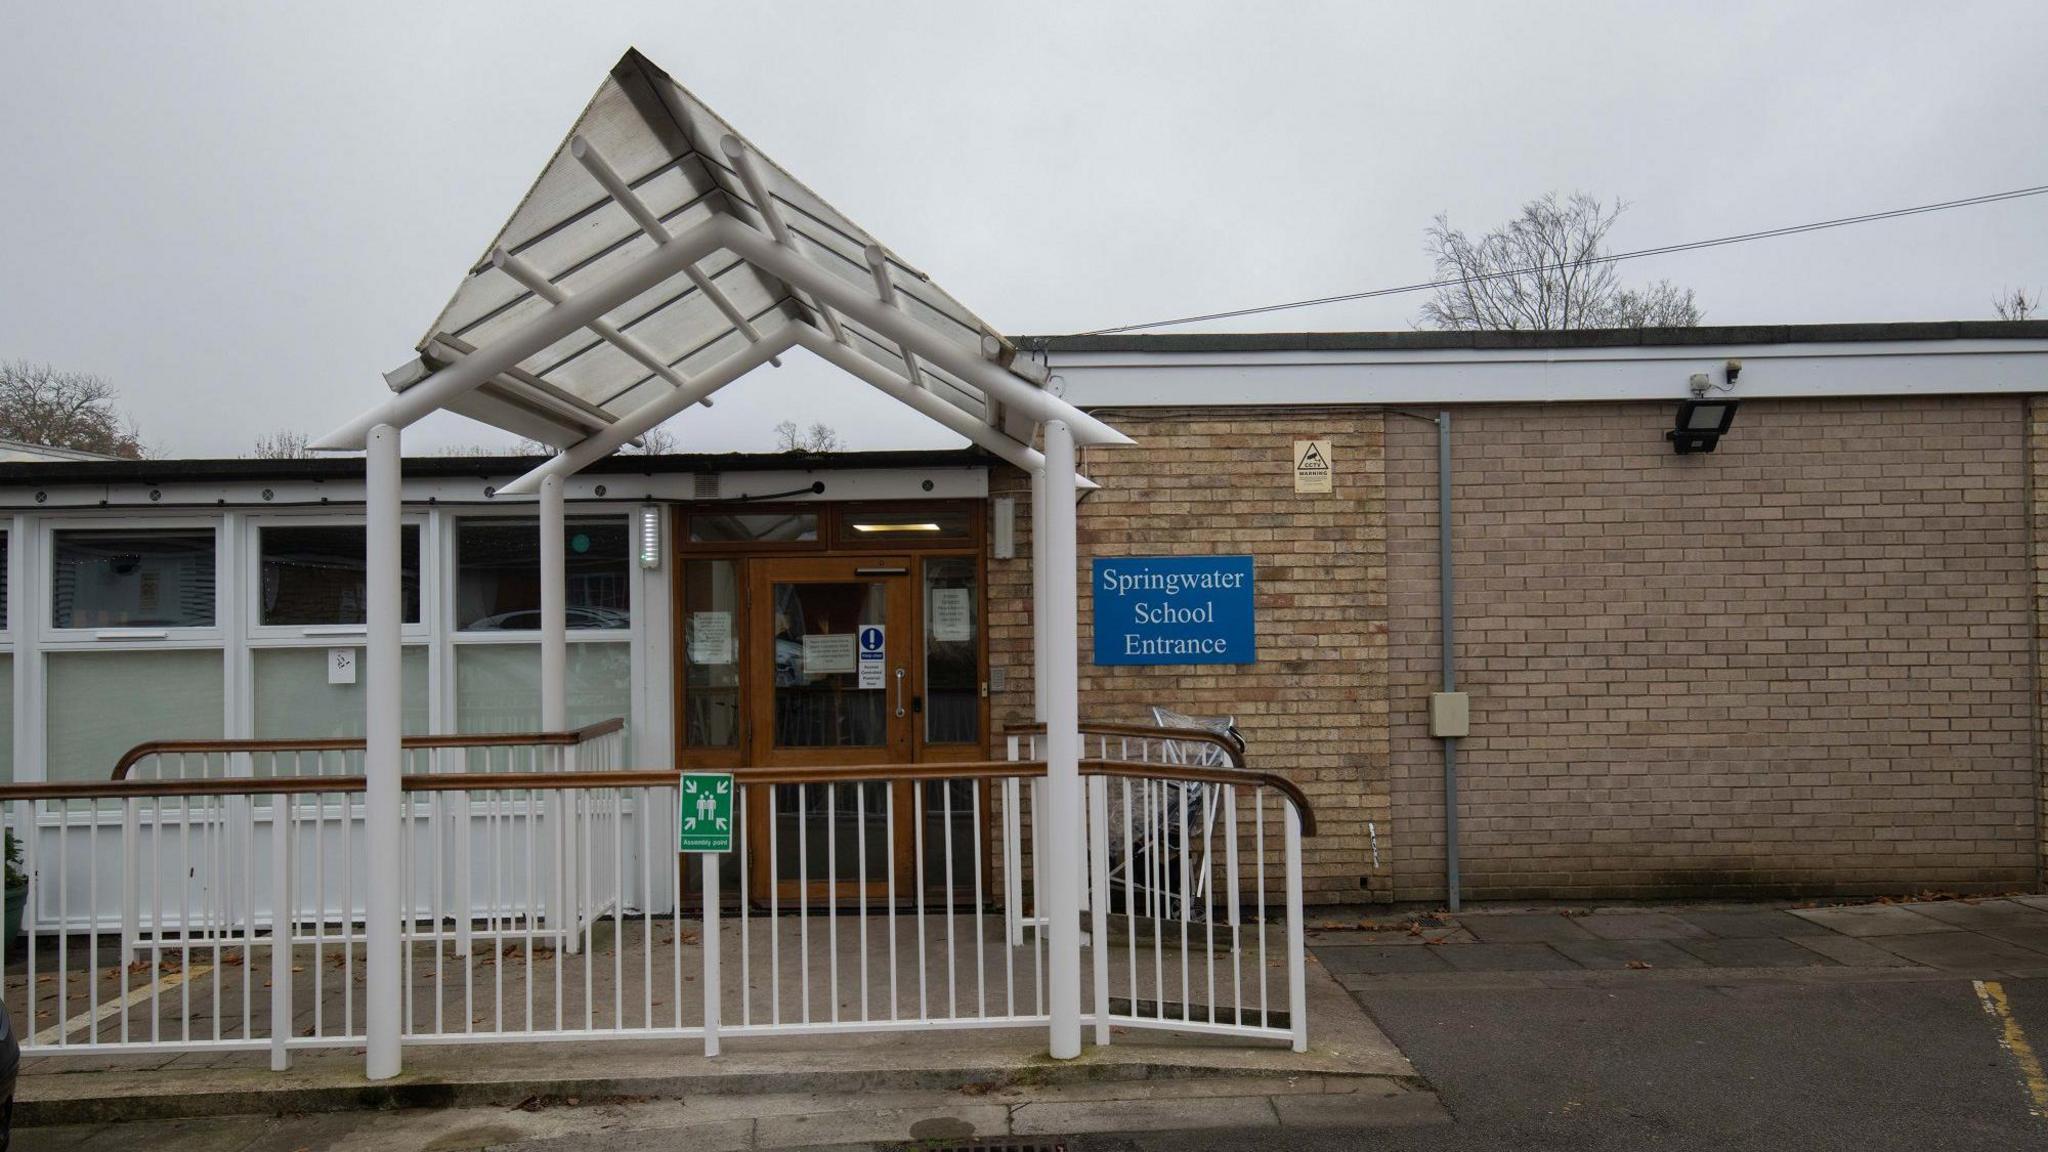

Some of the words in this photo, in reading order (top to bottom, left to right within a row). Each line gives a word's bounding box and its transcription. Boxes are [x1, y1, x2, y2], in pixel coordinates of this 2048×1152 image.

[1103, 568, 1245, 596] Springwater
[1135, 601, 1215, 624] School
[1124, 634, 1227, 655] Entrance
